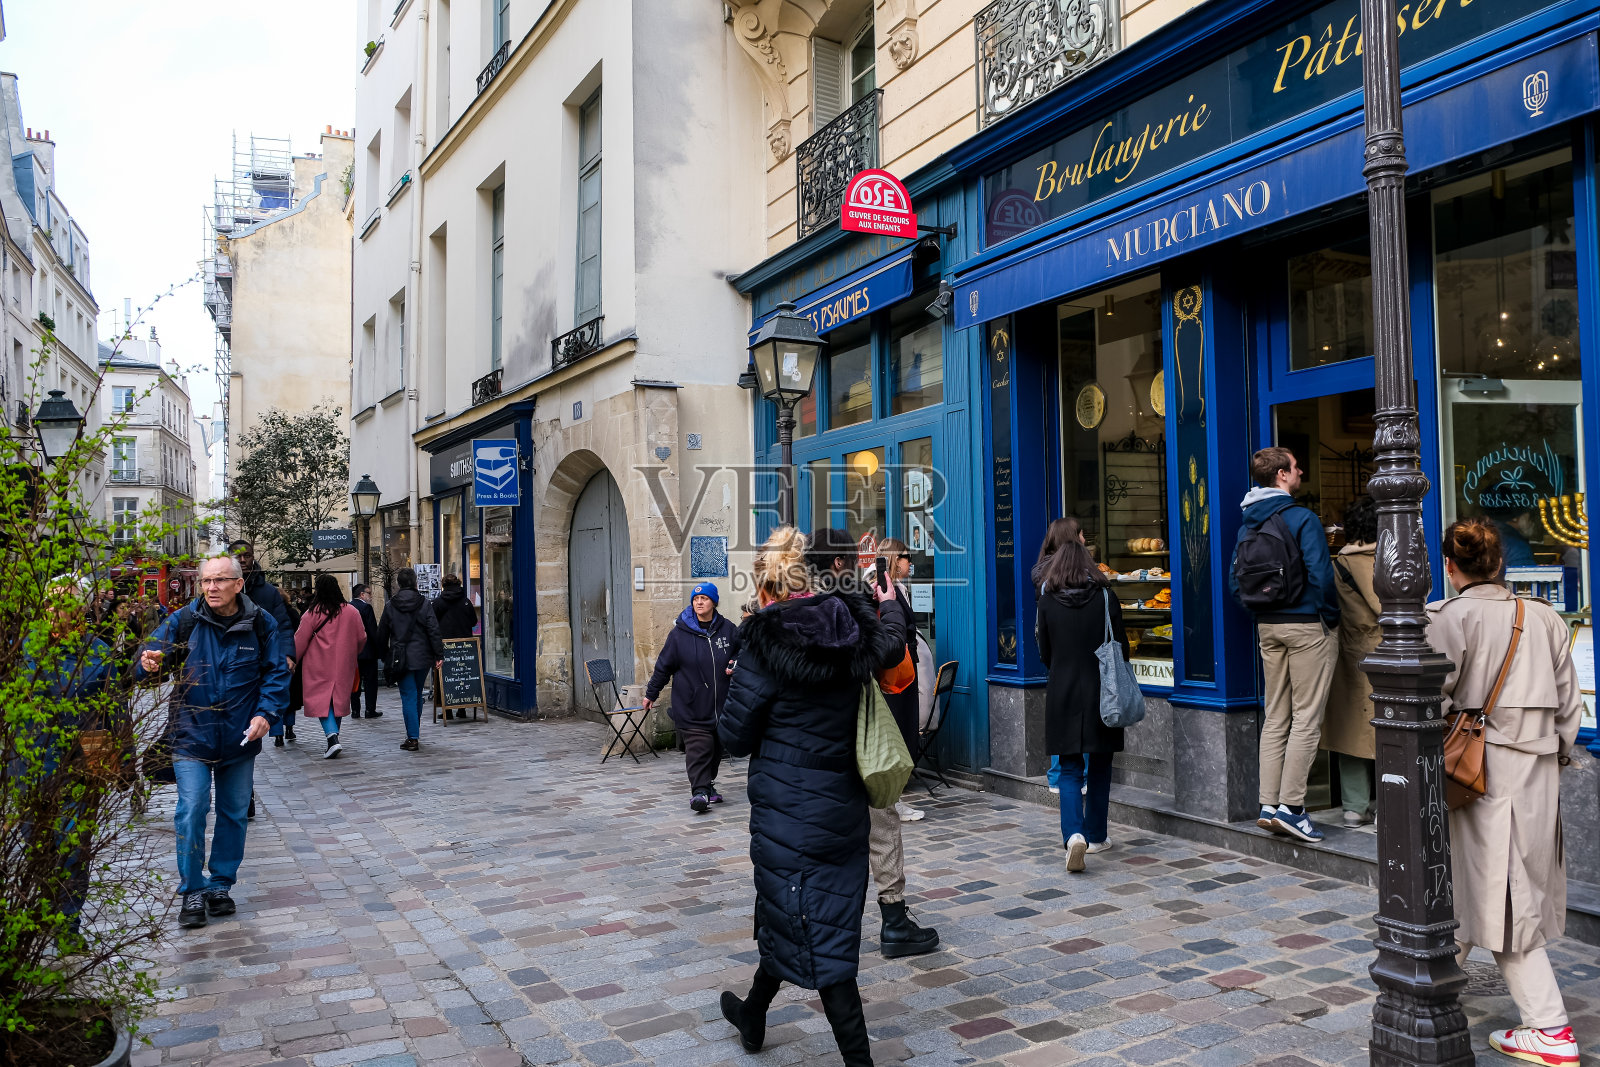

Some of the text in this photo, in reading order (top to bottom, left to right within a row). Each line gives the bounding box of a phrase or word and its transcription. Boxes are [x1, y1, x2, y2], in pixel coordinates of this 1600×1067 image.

[1033, 94, 1212, 203] Boulangerie
[859, 182, 896, 208] OSE
[848, 211, 910, 225] ŒUVRE DE SECOURS
[858, 220, 901, 233] AUX ENFANTS
[1106, 180, 1271, 268] MURCIANO
[821, 287, 870, 330] PSAUMES
[574, 403, 581, 419] 18
[1131, 662, 1174, 678] URCIAN
